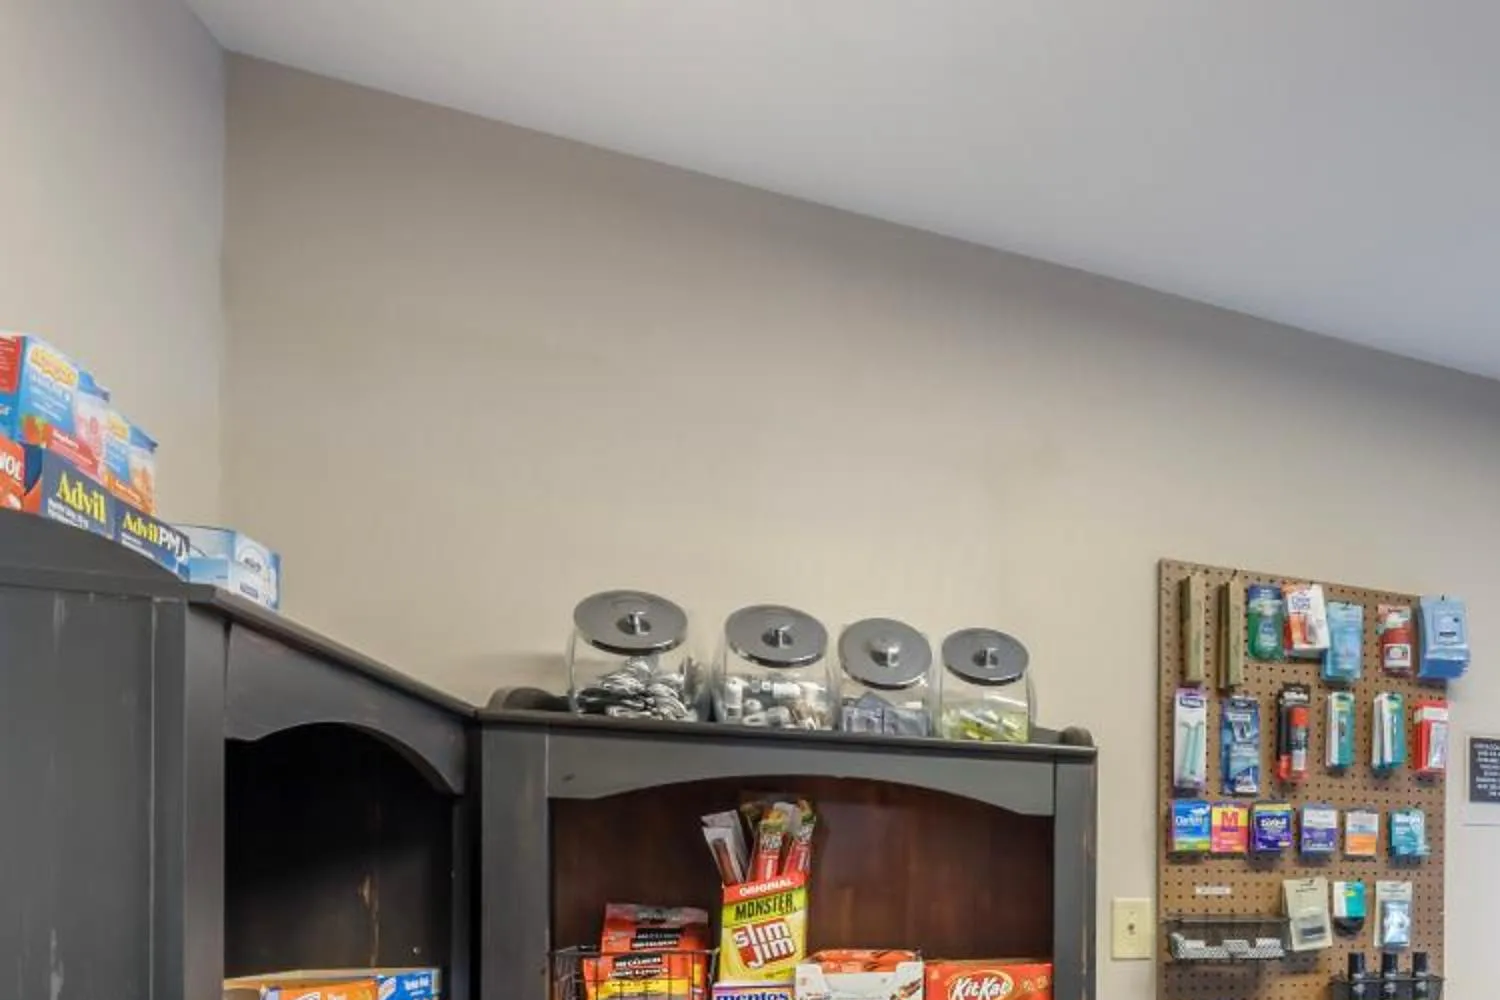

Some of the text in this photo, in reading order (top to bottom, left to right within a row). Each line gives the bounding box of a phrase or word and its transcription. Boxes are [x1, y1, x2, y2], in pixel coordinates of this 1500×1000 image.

[56, 472, 107, 524] Advil
[122, 511, 159, 543] Advil
[739, 878, 793, 897] ORIGINAL
[735, 892, 796, 921] MONSTER
